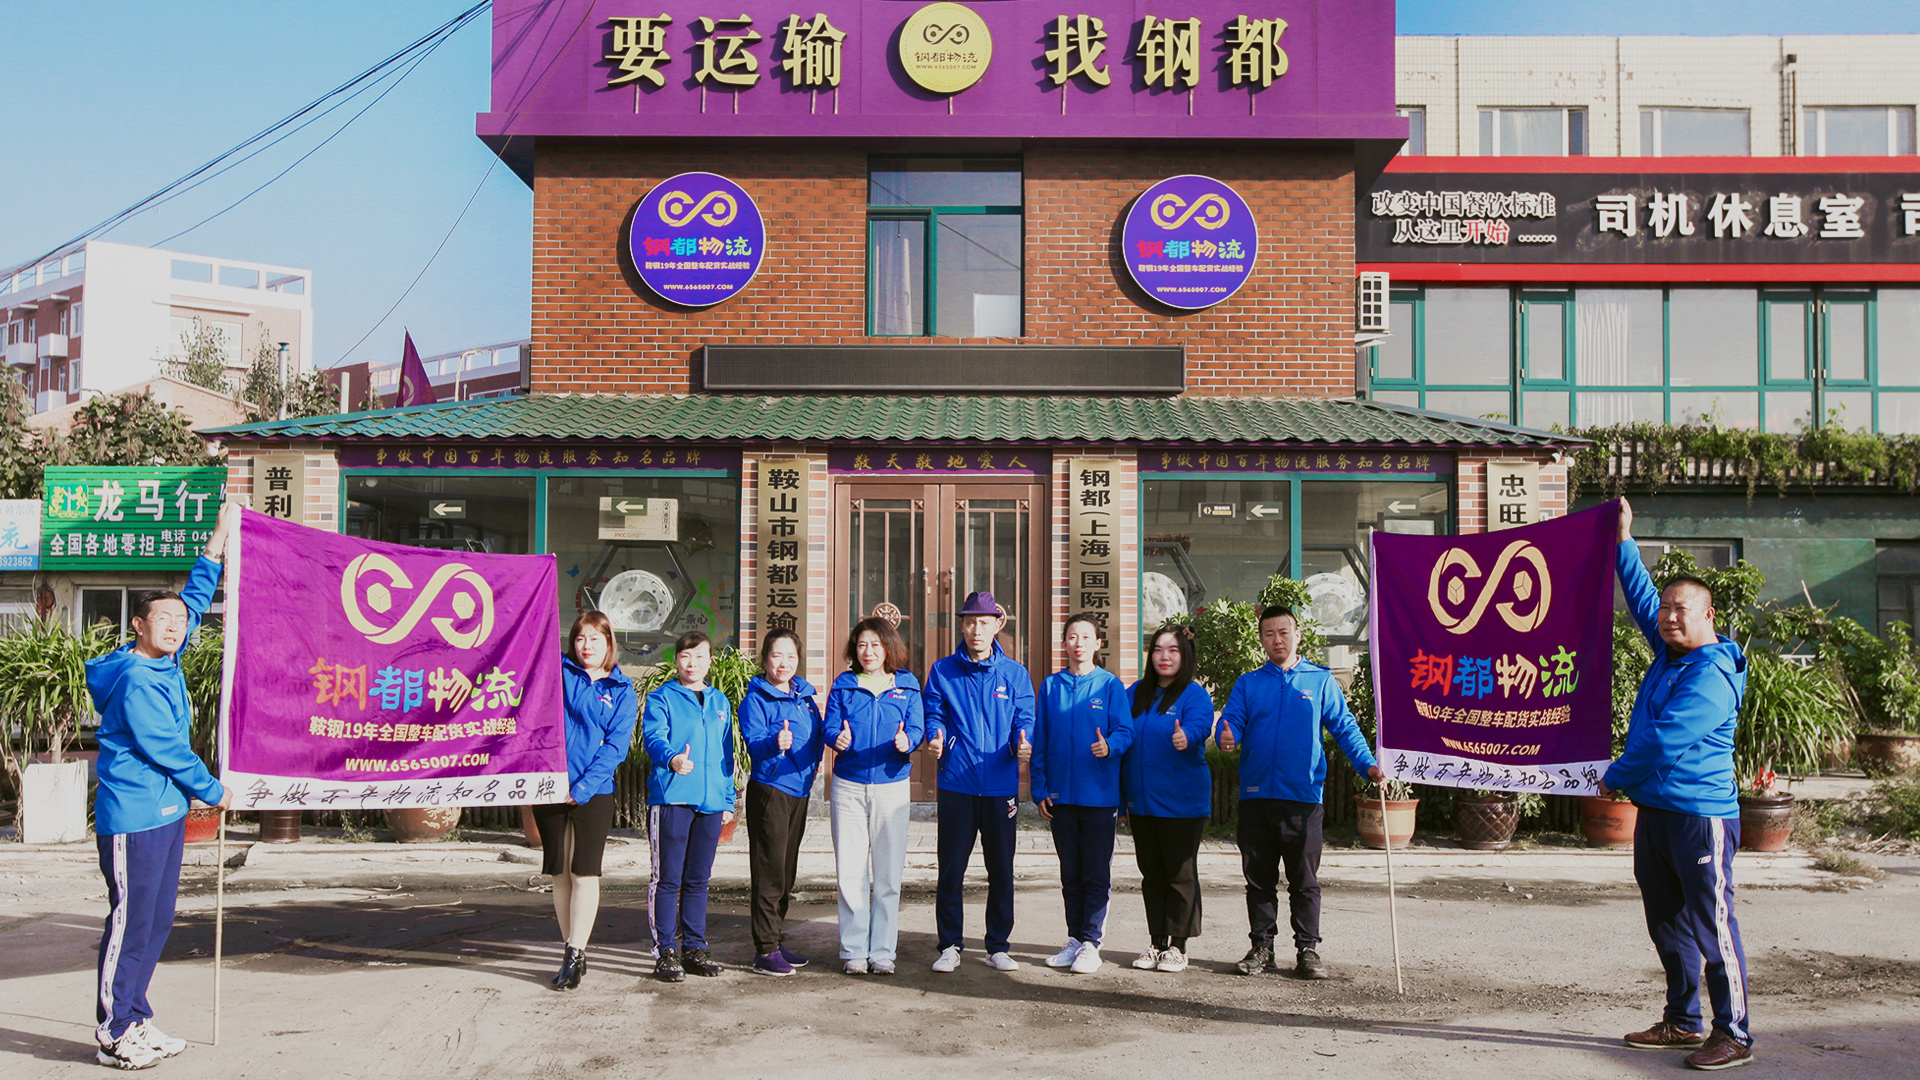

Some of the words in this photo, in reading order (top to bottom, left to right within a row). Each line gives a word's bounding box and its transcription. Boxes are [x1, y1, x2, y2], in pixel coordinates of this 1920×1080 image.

[605, 13, 847, 87] 要运输
[915, 52, 978, 63] 钢都物流
[1045, 14, 1289, 87] 找钢都
[1372, 190, 1556, 217] 改变中国餐饮标准
[1596, 192, 1865, 239] 司机休息室
[643, 236, 752, 256] 钢都物流
[1136, 239, 1245, 259] 钢都物流
[375, 448, 701, 466] 争做中国百年物流服务知名品牌
[1161, 451, 1431, 470] 争做中国百年物流服务知名品牌
[93, 480, 227, 522] 龙马行
[264, 466, 293, 518] 普利
[1499, 474, 1528, 524] 忠旺
[50, 533, 155, 557] 全国各地零担
[161, 529, 186, 542] 电话
[159, 544, 185, 557] 手机
[308, 657, 524, 713] 钢都物流
[1409, 645, 1580, 700] 钢都物流
[309, 716, 517, 742] 鞍钢19年全国整车配货实战经验
[1441, 736, 1541, 755] WWW.6565007.COM
[345, 753, 490, 772] WWW.6565007.COM
